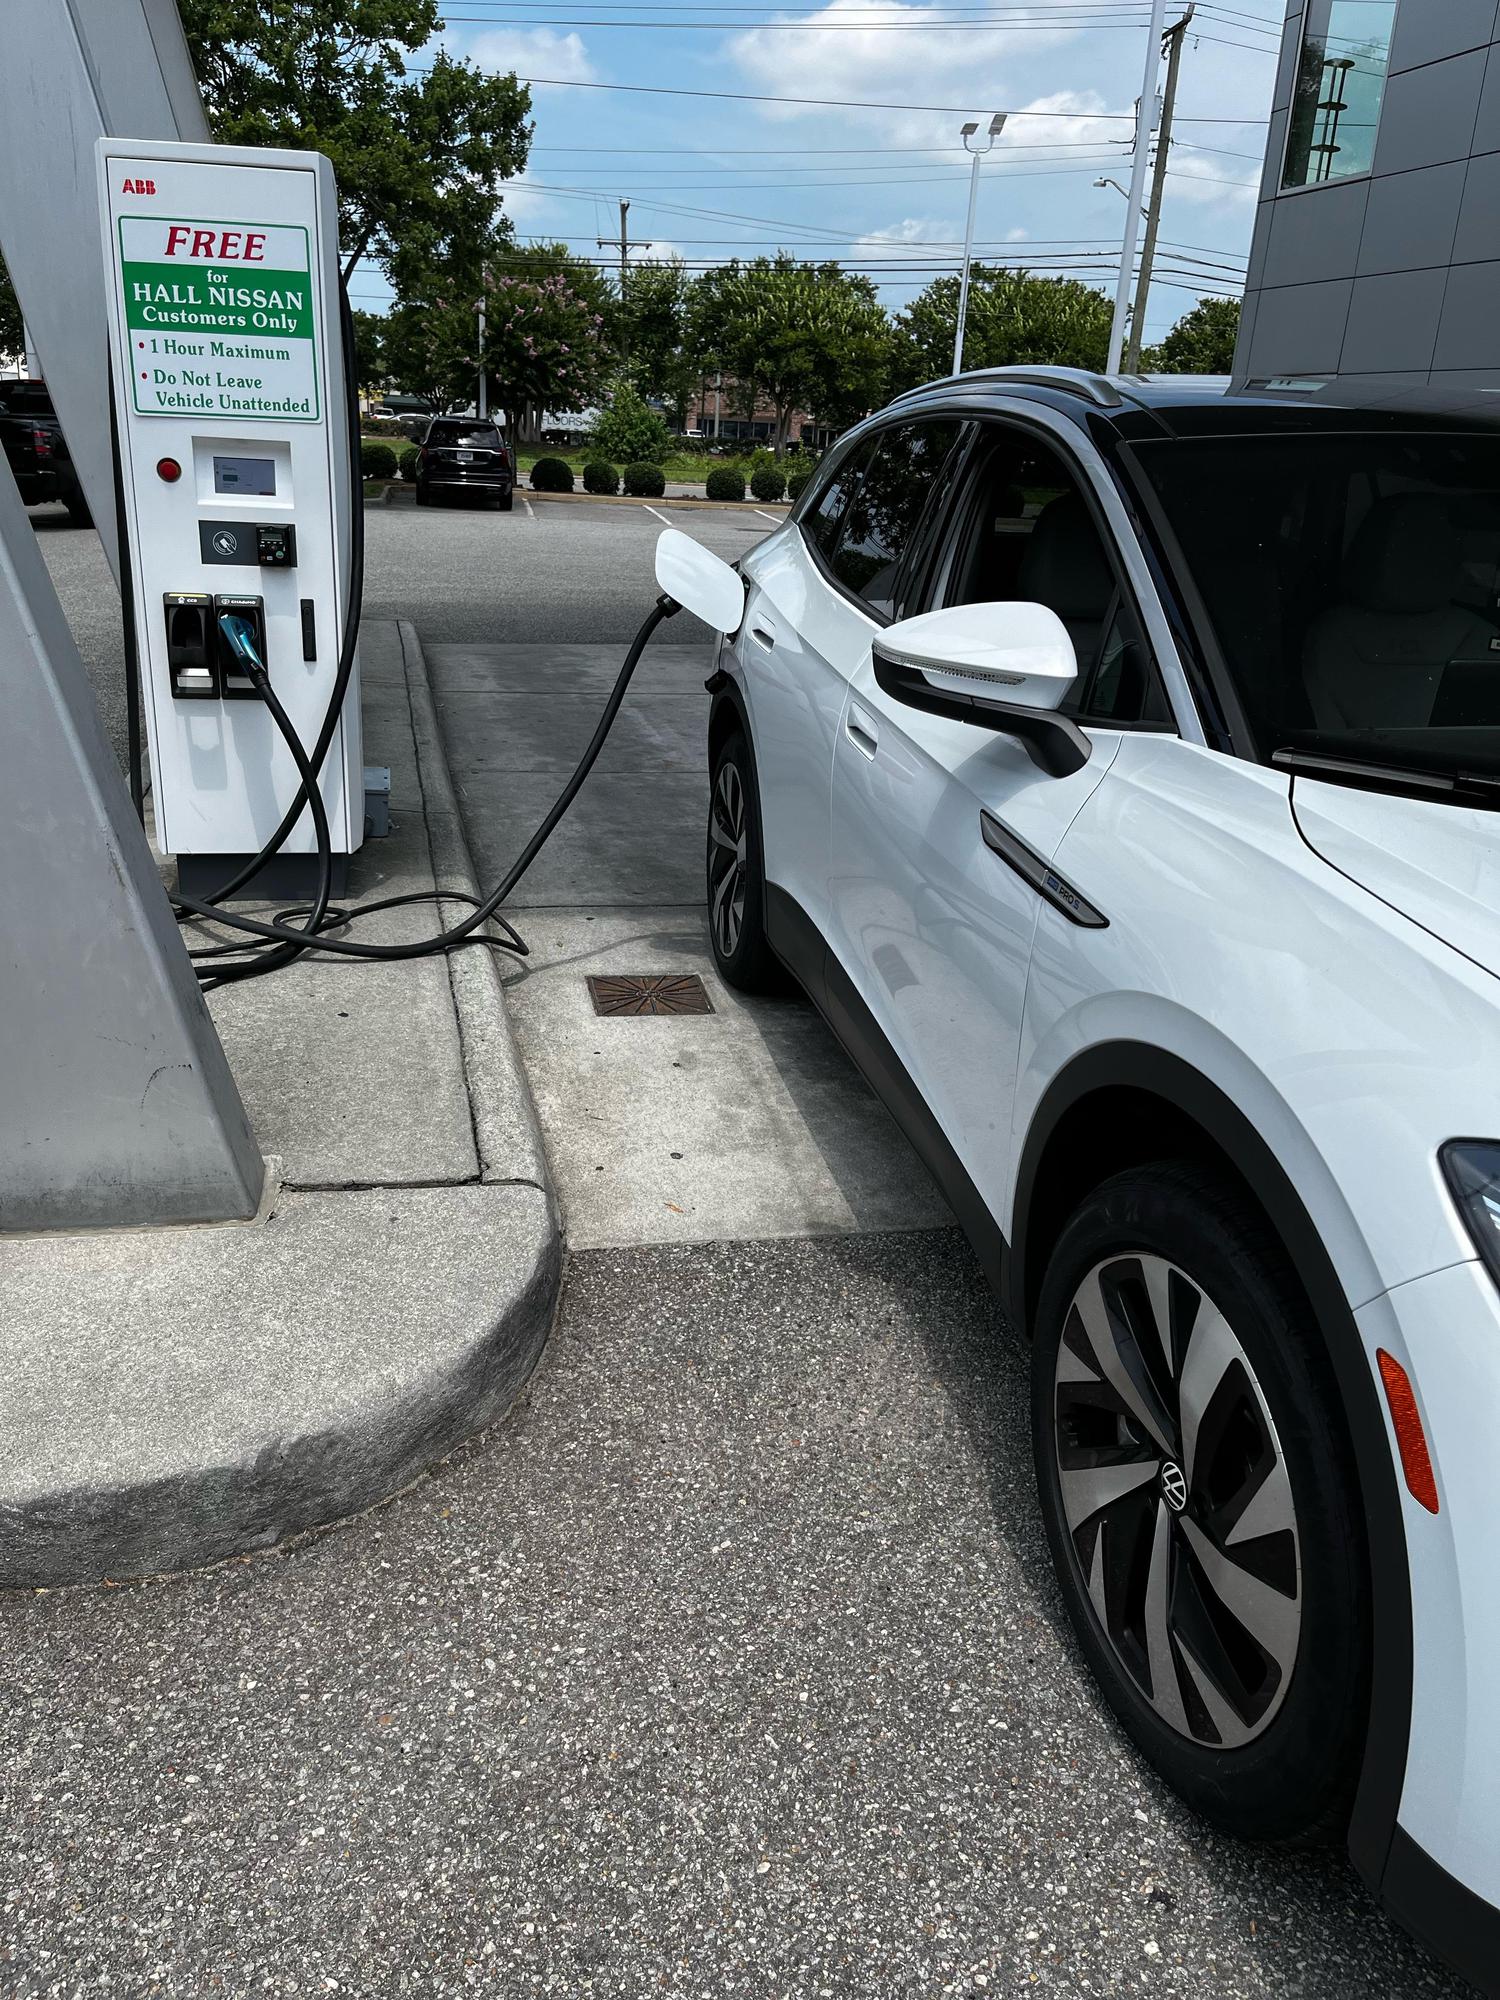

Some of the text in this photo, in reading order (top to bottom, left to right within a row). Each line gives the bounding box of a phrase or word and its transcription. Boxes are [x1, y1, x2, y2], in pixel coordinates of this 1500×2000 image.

[122, 178, 156, 195] ABB
[164, 226, 266, 261] FREE
[206, 270, 228, 284] for
[133, 282, 303, 311] HALL NISSAN
[142, 306, 298, 333] Customers Only
[150, 339, 290, 360] 1 Hour Maximum
[153, 369, 263, 389] Do Not Leave
[155, 391, 310, 413] Vehicle Unattended
[1059, 886, 1080, 910] PRO S
